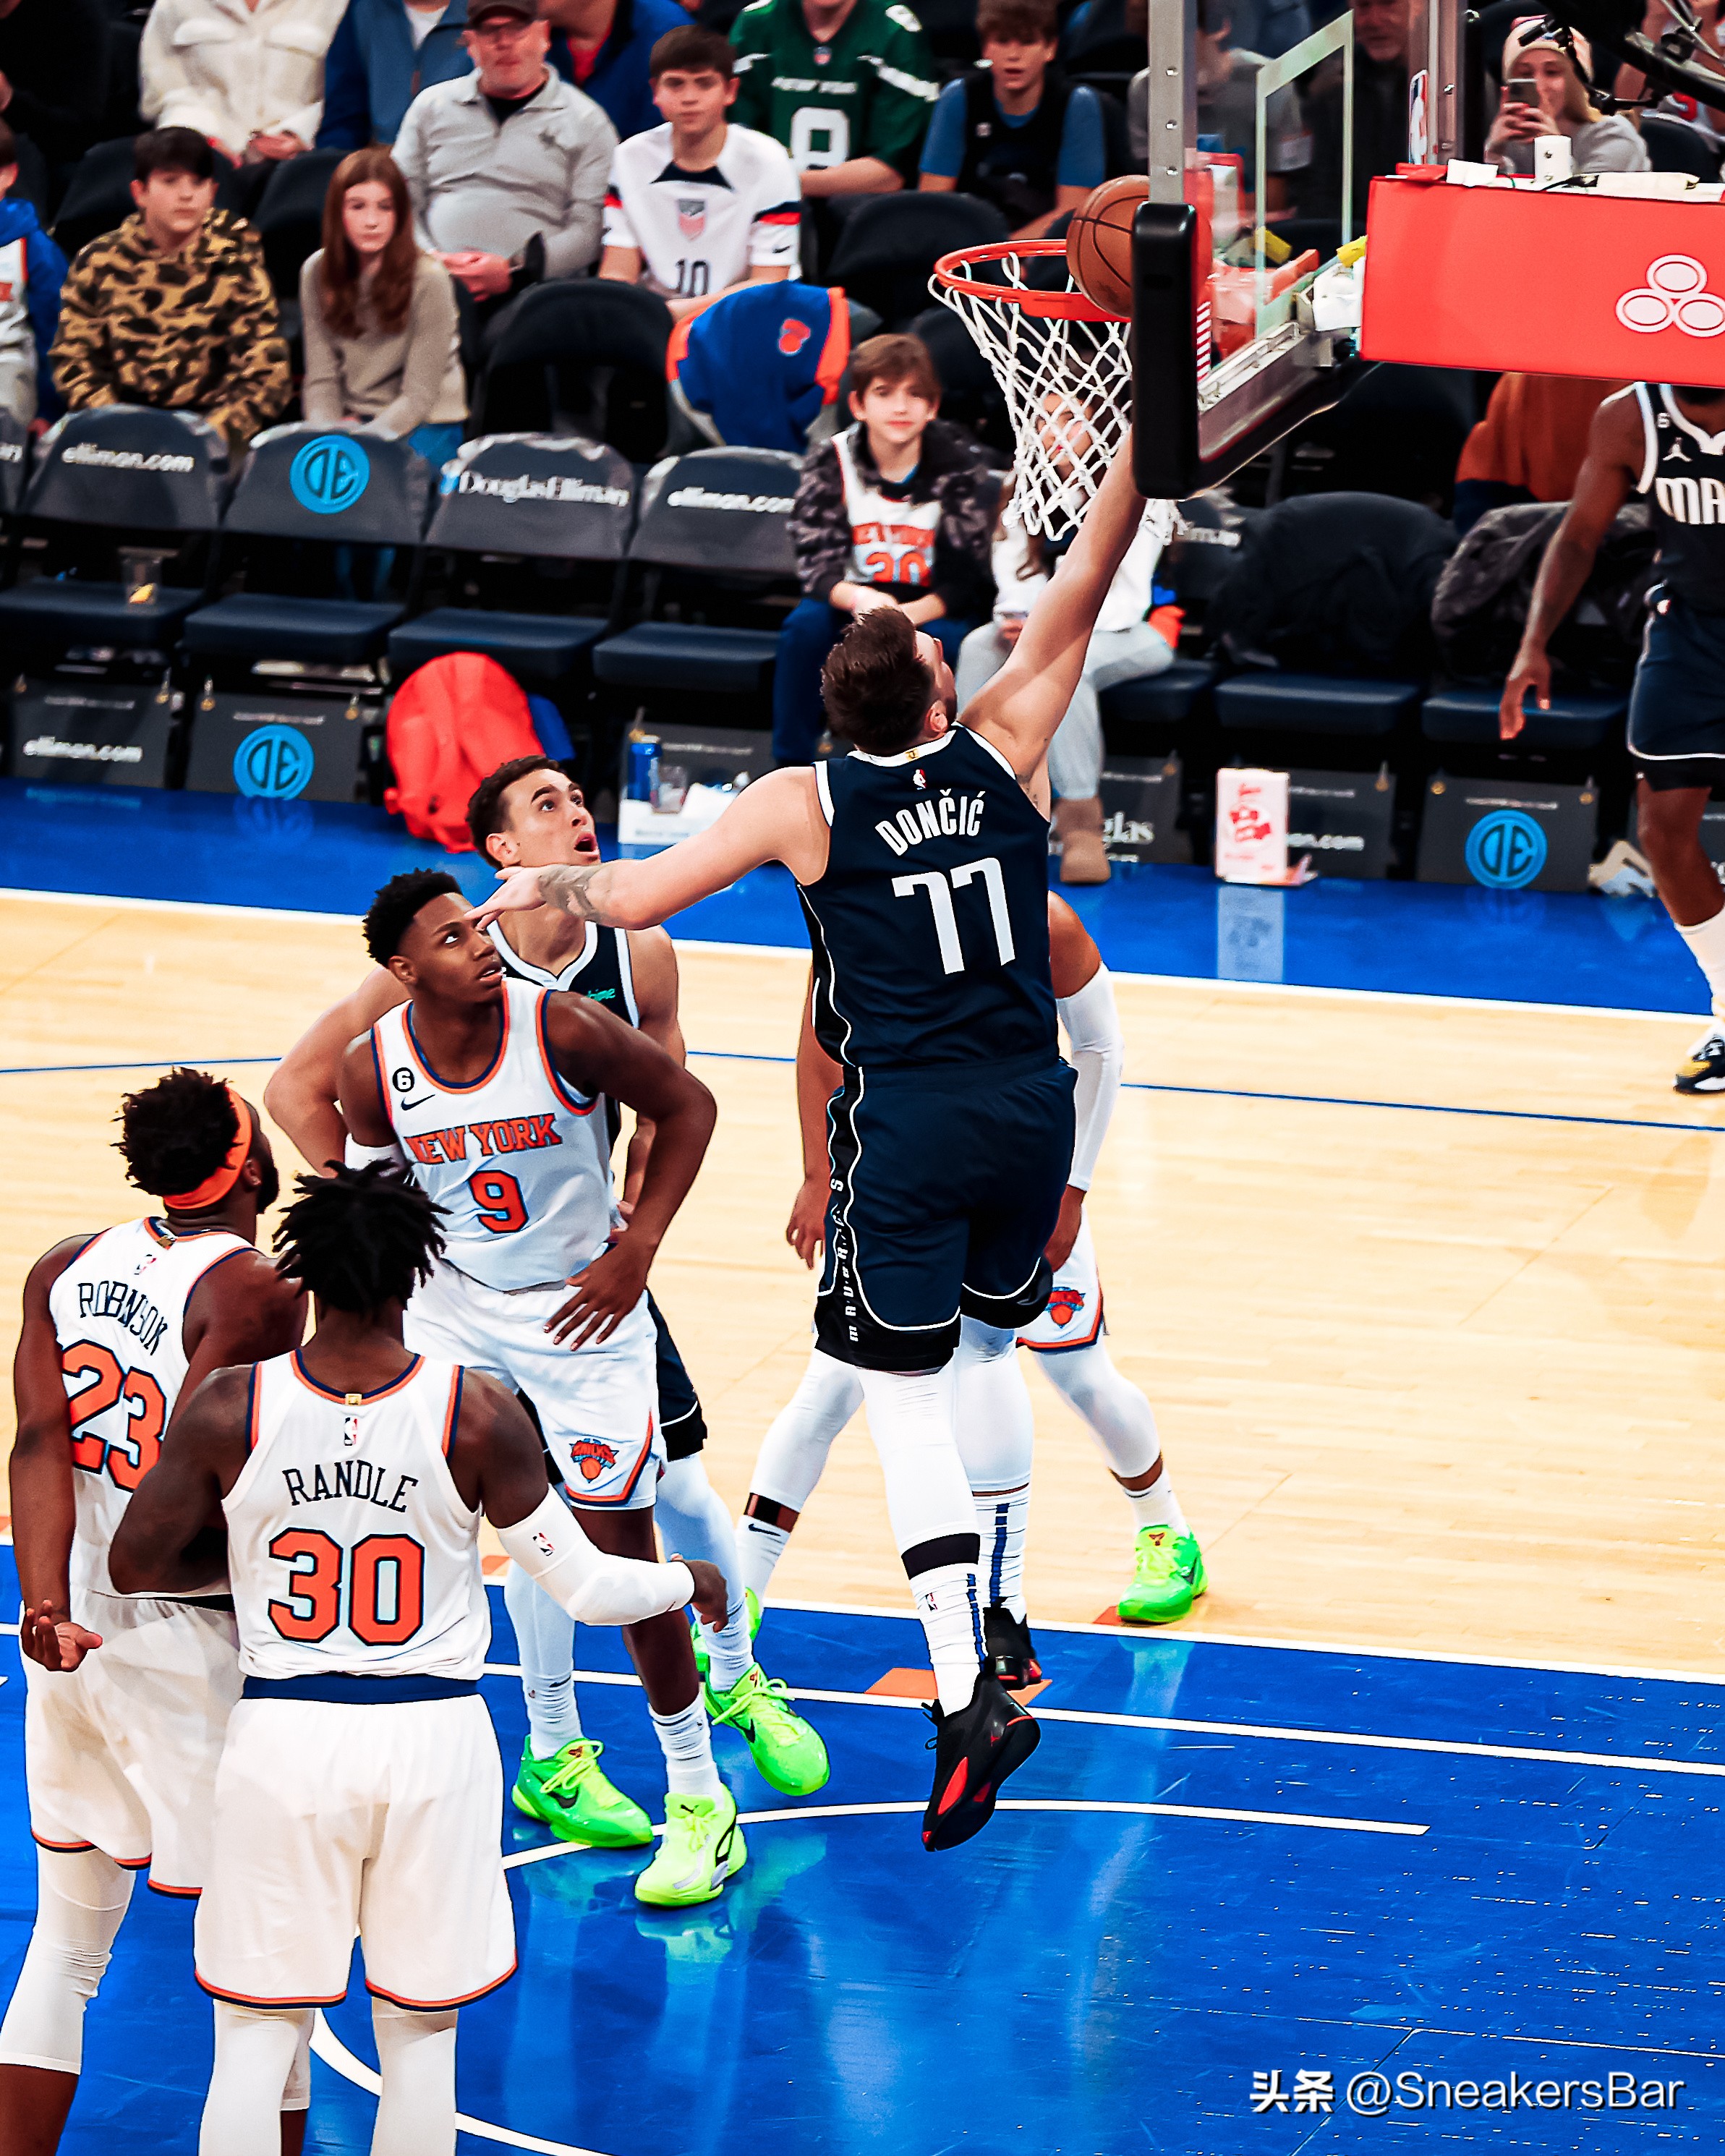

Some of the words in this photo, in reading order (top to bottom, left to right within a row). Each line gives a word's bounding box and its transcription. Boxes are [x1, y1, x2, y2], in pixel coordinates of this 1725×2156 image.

[676, 258, 710, 297] 10
[874, 788, 986, 856] DONČIĆ
[1102, 811, 1155, 851] glas
[891, 857, 1015, 975] 77
[396, 1070, 412, 1091] 6
[469, 1112, 563, 1157] YORK
[467, 1169, 529, 1234] 9
[76, 1280, 168, 1356] ROBNSON
[61, 1339, 167, 1493] 23
[282, 1460, 419, 1512] RANDLE
[268, 1527, 425, 1646] 30
